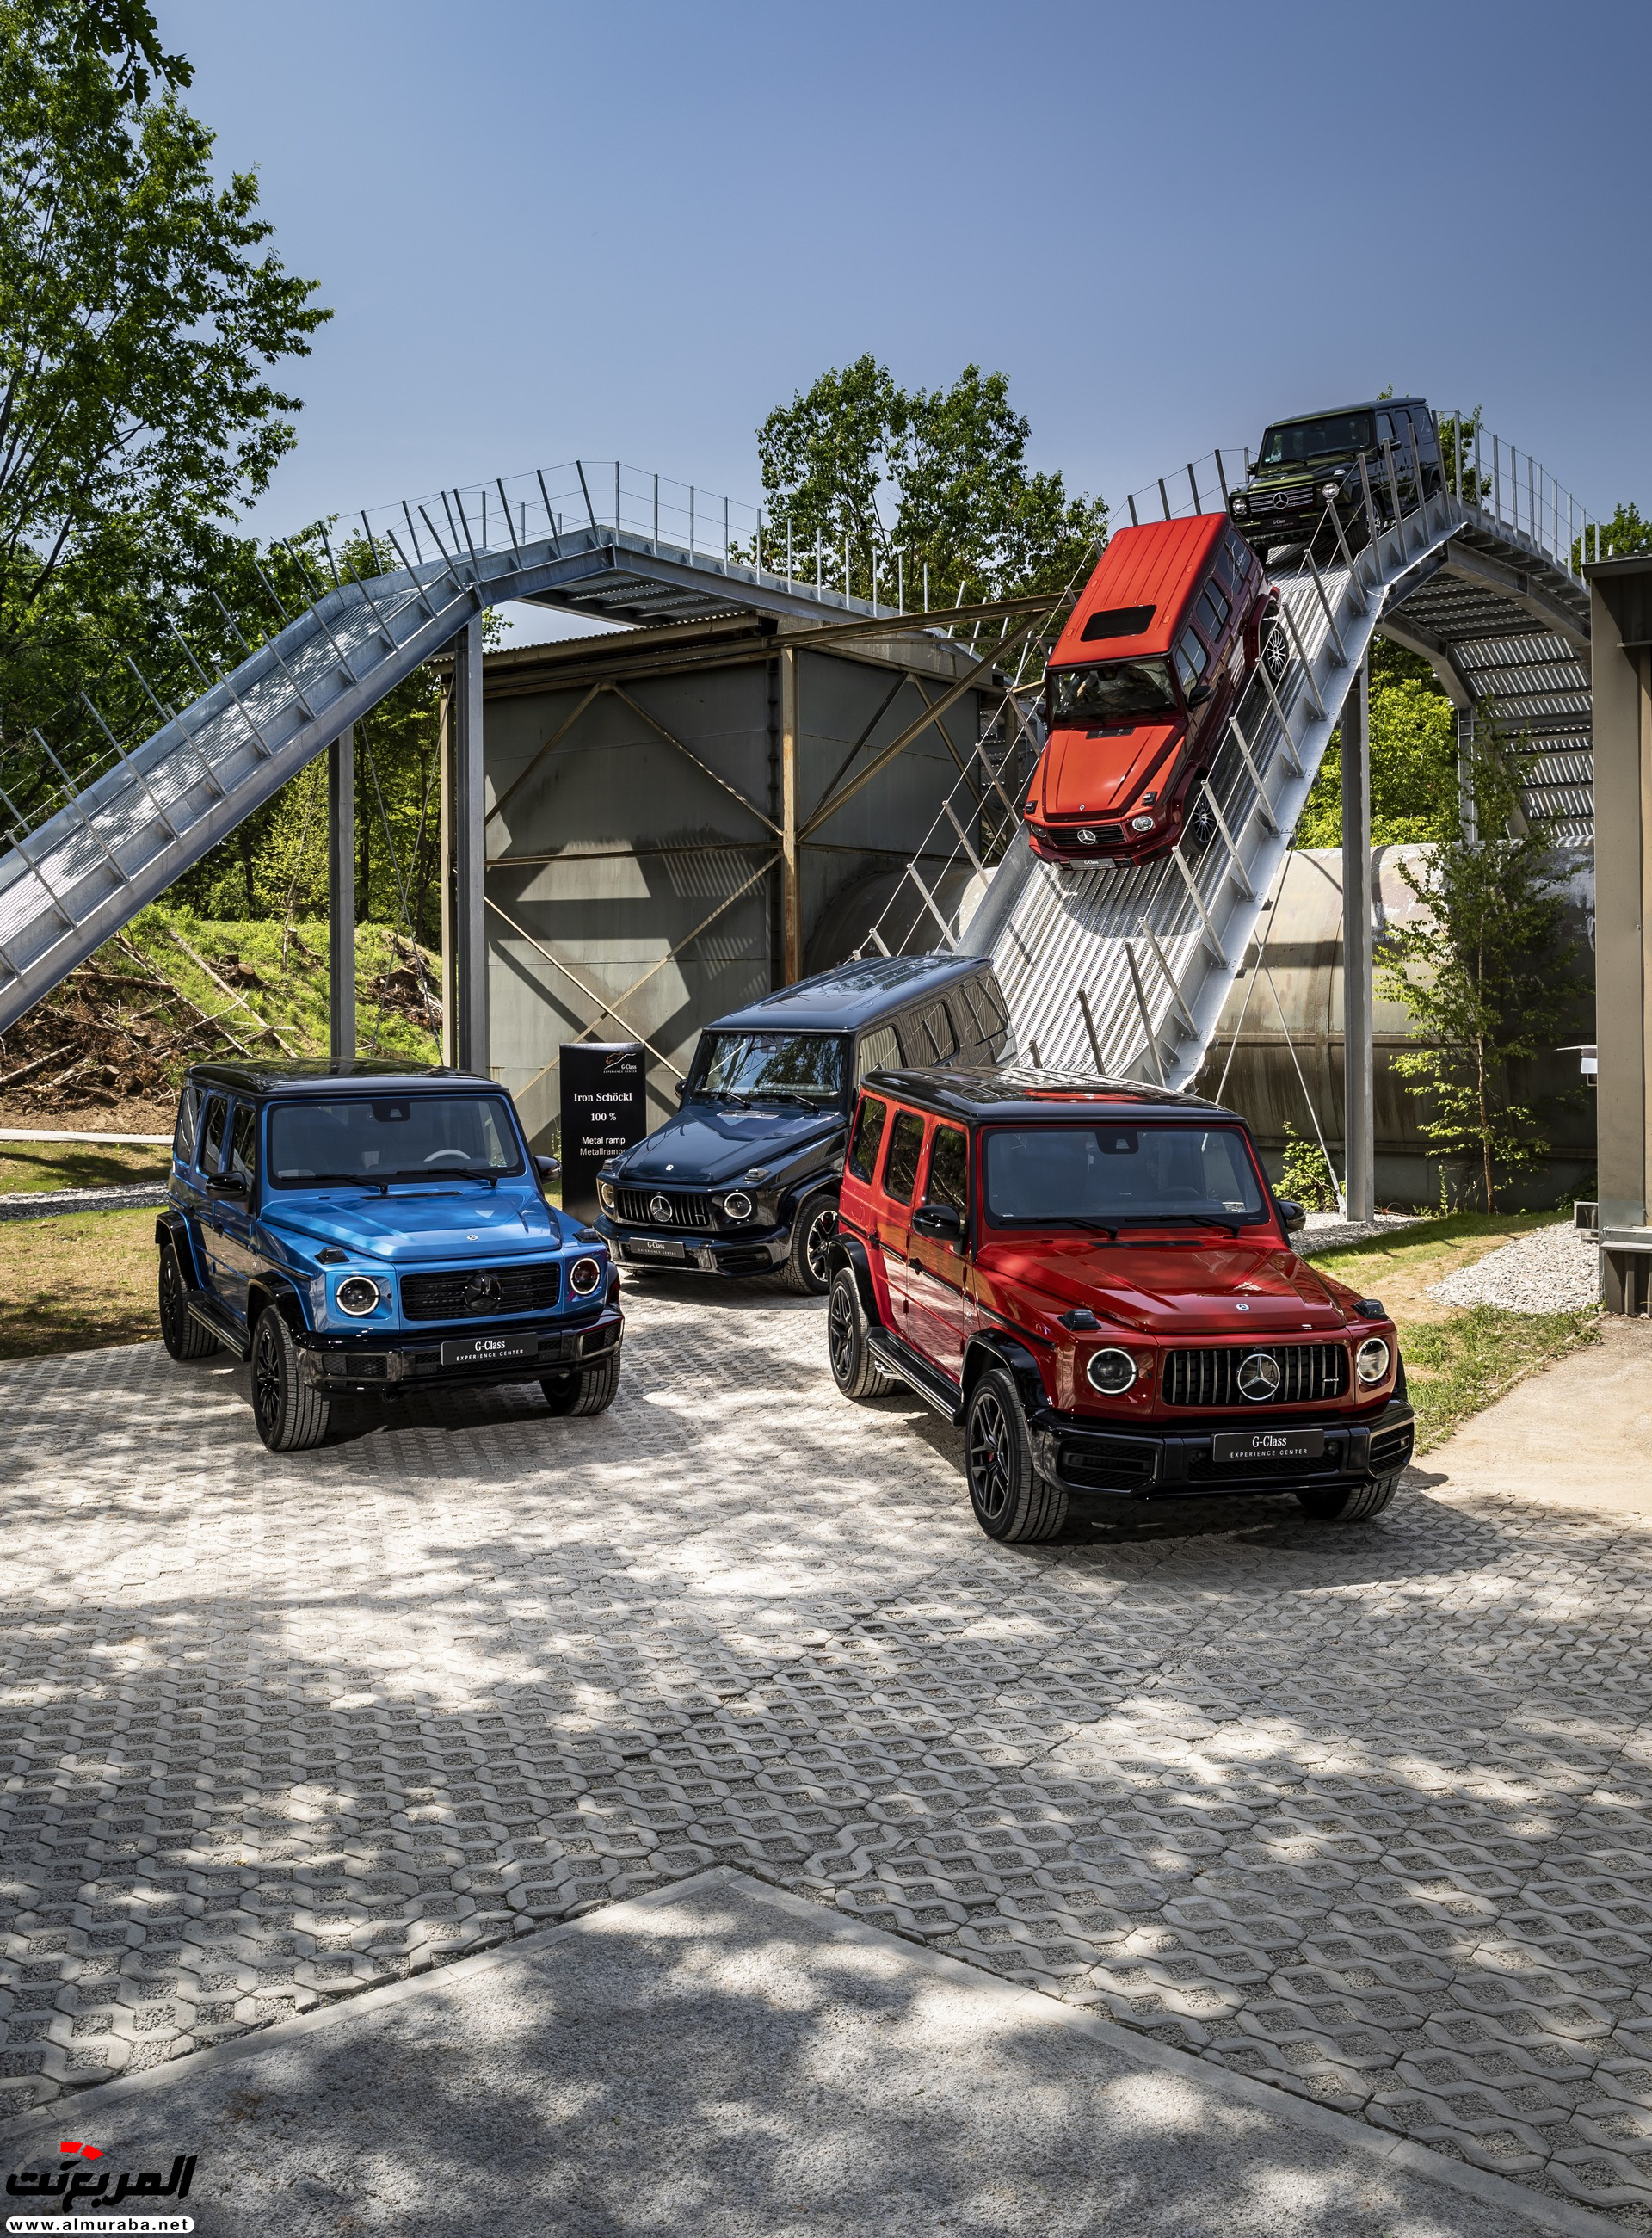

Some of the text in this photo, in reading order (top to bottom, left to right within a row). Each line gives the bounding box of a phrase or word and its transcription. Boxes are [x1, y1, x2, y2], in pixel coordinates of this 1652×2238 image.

[573, 1092, 632, 1101] Iron Schöckl
[590, 1112, 617, 1121] 100 %
[582, 1136, 604, 1144] Metal
[647, 1241, 665, 1249] G-Class
[474, 1341, 506, 1351] G-Class
[456, 1348, 524, 1361] EXPERIENCE CENTER
[1252, 1435, 1287, 1447] G-Class
[1230, 1450, 1276, 1458] EXPERIENCE
